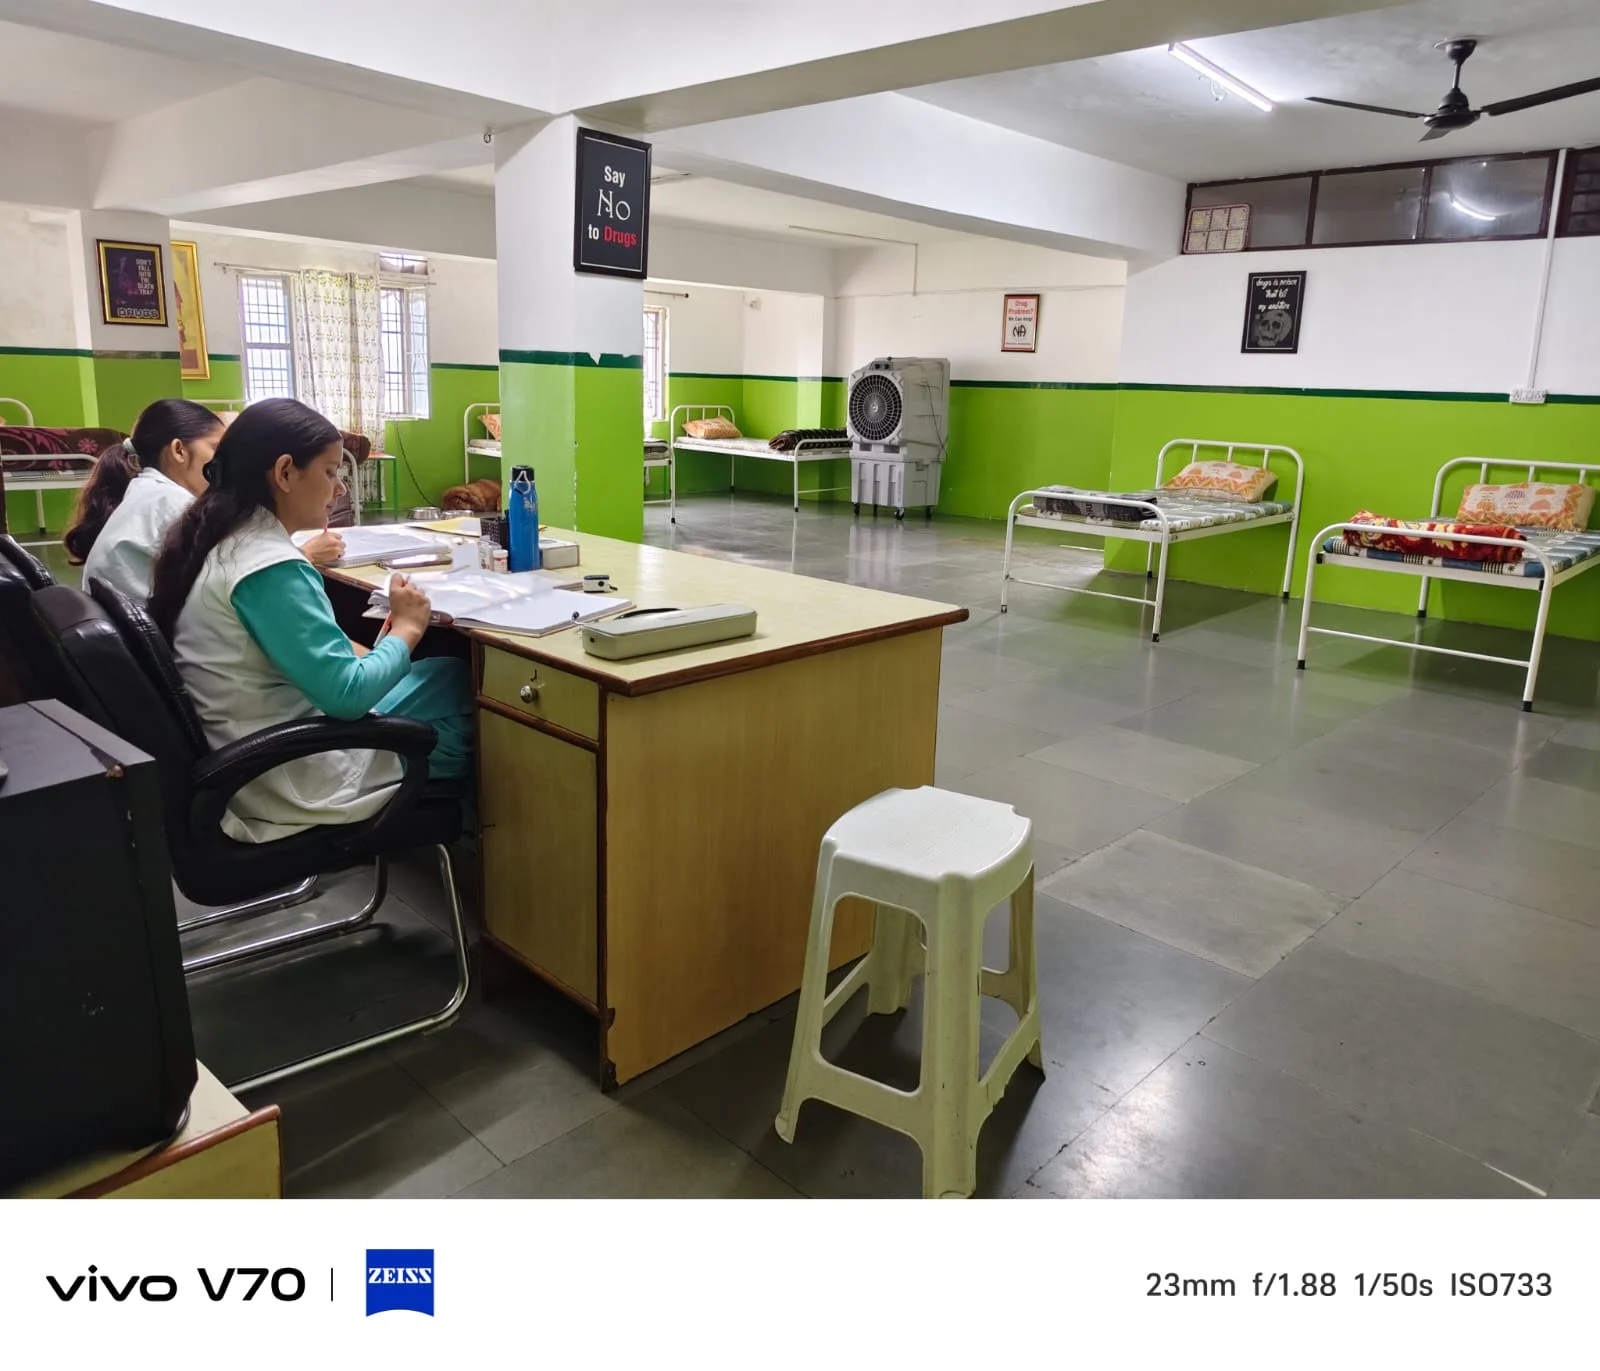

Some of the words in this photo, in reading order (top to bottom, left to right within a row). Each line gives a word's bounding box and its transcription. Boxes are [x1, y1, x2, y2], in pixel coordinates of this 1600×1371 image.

[604, 165, 626, 188] Say
[597, 188, 631, 221] No
[588, 223, 600, 240] to
[604, 226, 637, 248] Drugs
